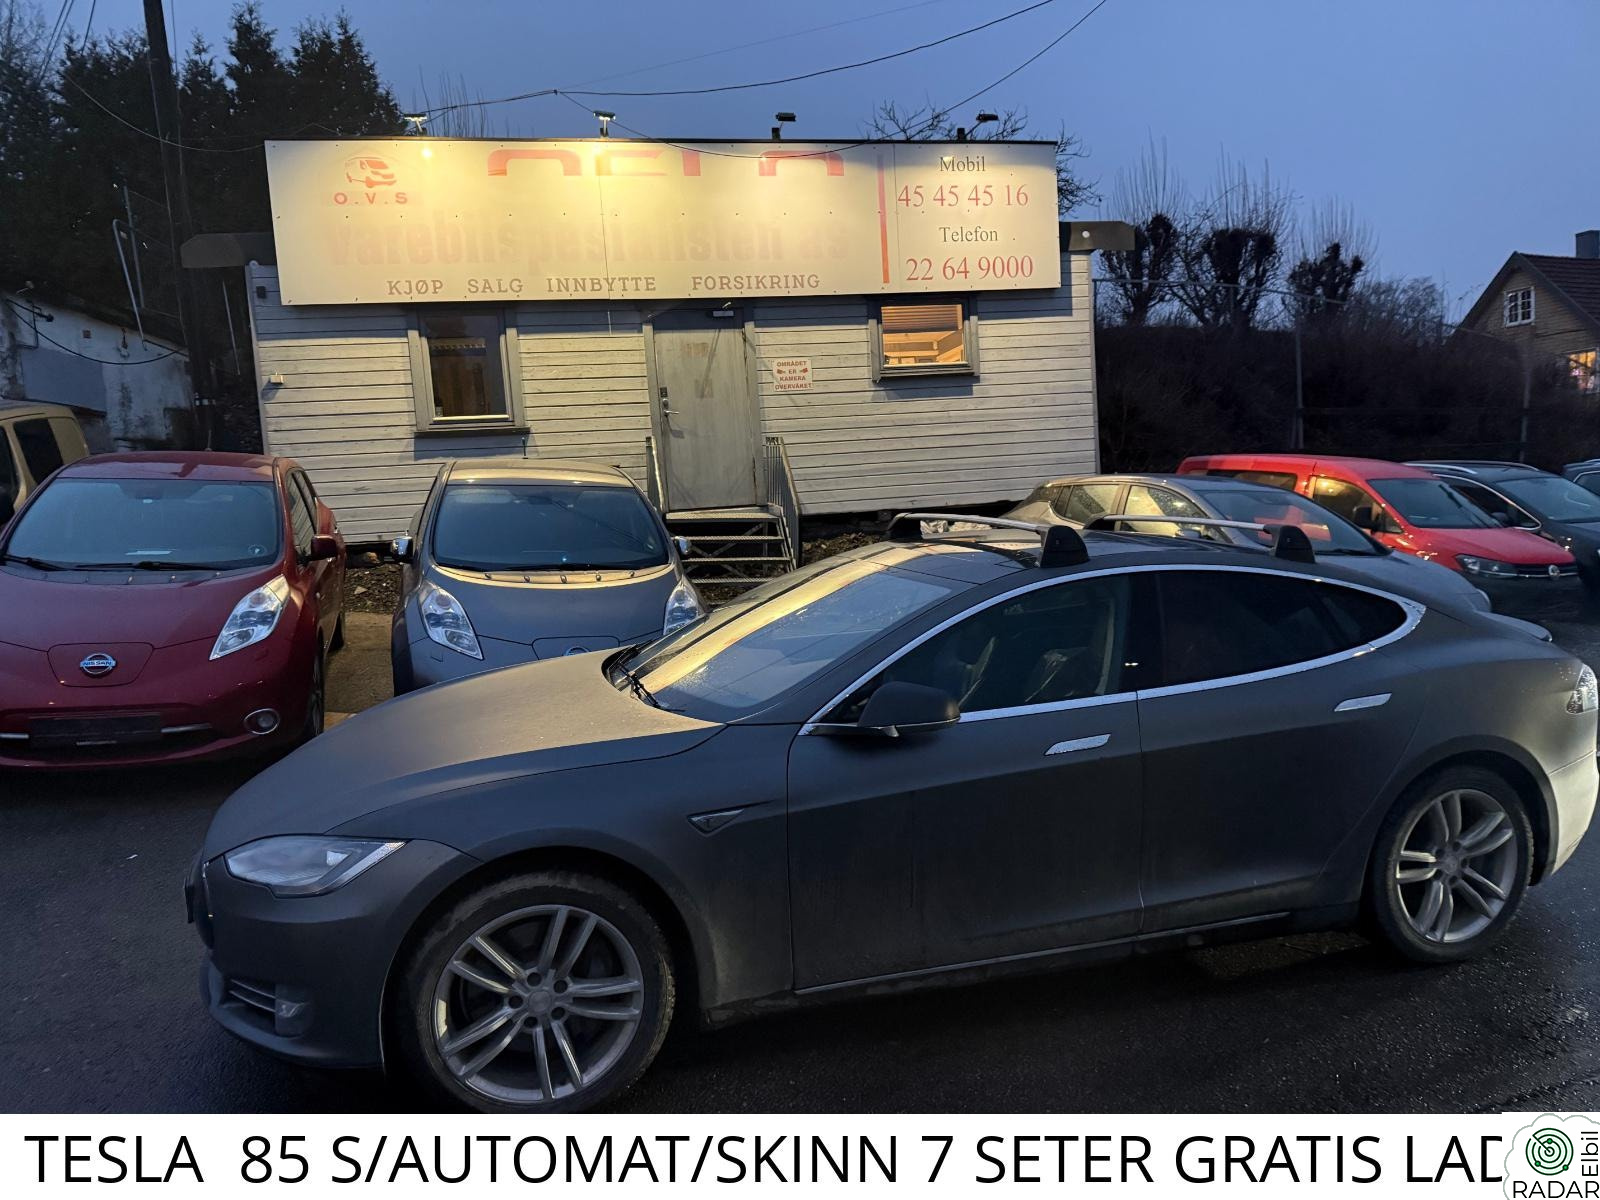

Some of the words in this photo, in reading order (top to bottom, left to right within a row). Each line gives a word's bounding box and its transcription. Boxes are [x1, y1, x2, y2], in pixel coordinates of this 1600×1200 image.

[939, 156, 986, 173] Mobil
[897, 184, 924, 207] 45
[932, 184, 959, 207] 45
[967, 184, 994, 207] 45
[1004, 183, 1029, 206] 16
[938, 225, 998, 243] Telefon
[905, 258, 933, 282] 22
[942, 257, 970, 280] 64
[977, 255, 1034, 279] 9000
[387, 279, 444, 295] KJØP
[467, 278, 524, 294] SALG
[546, 276, 657, 293] INNBYTTE
[691, 274, 821, 291] FORSIKRING
